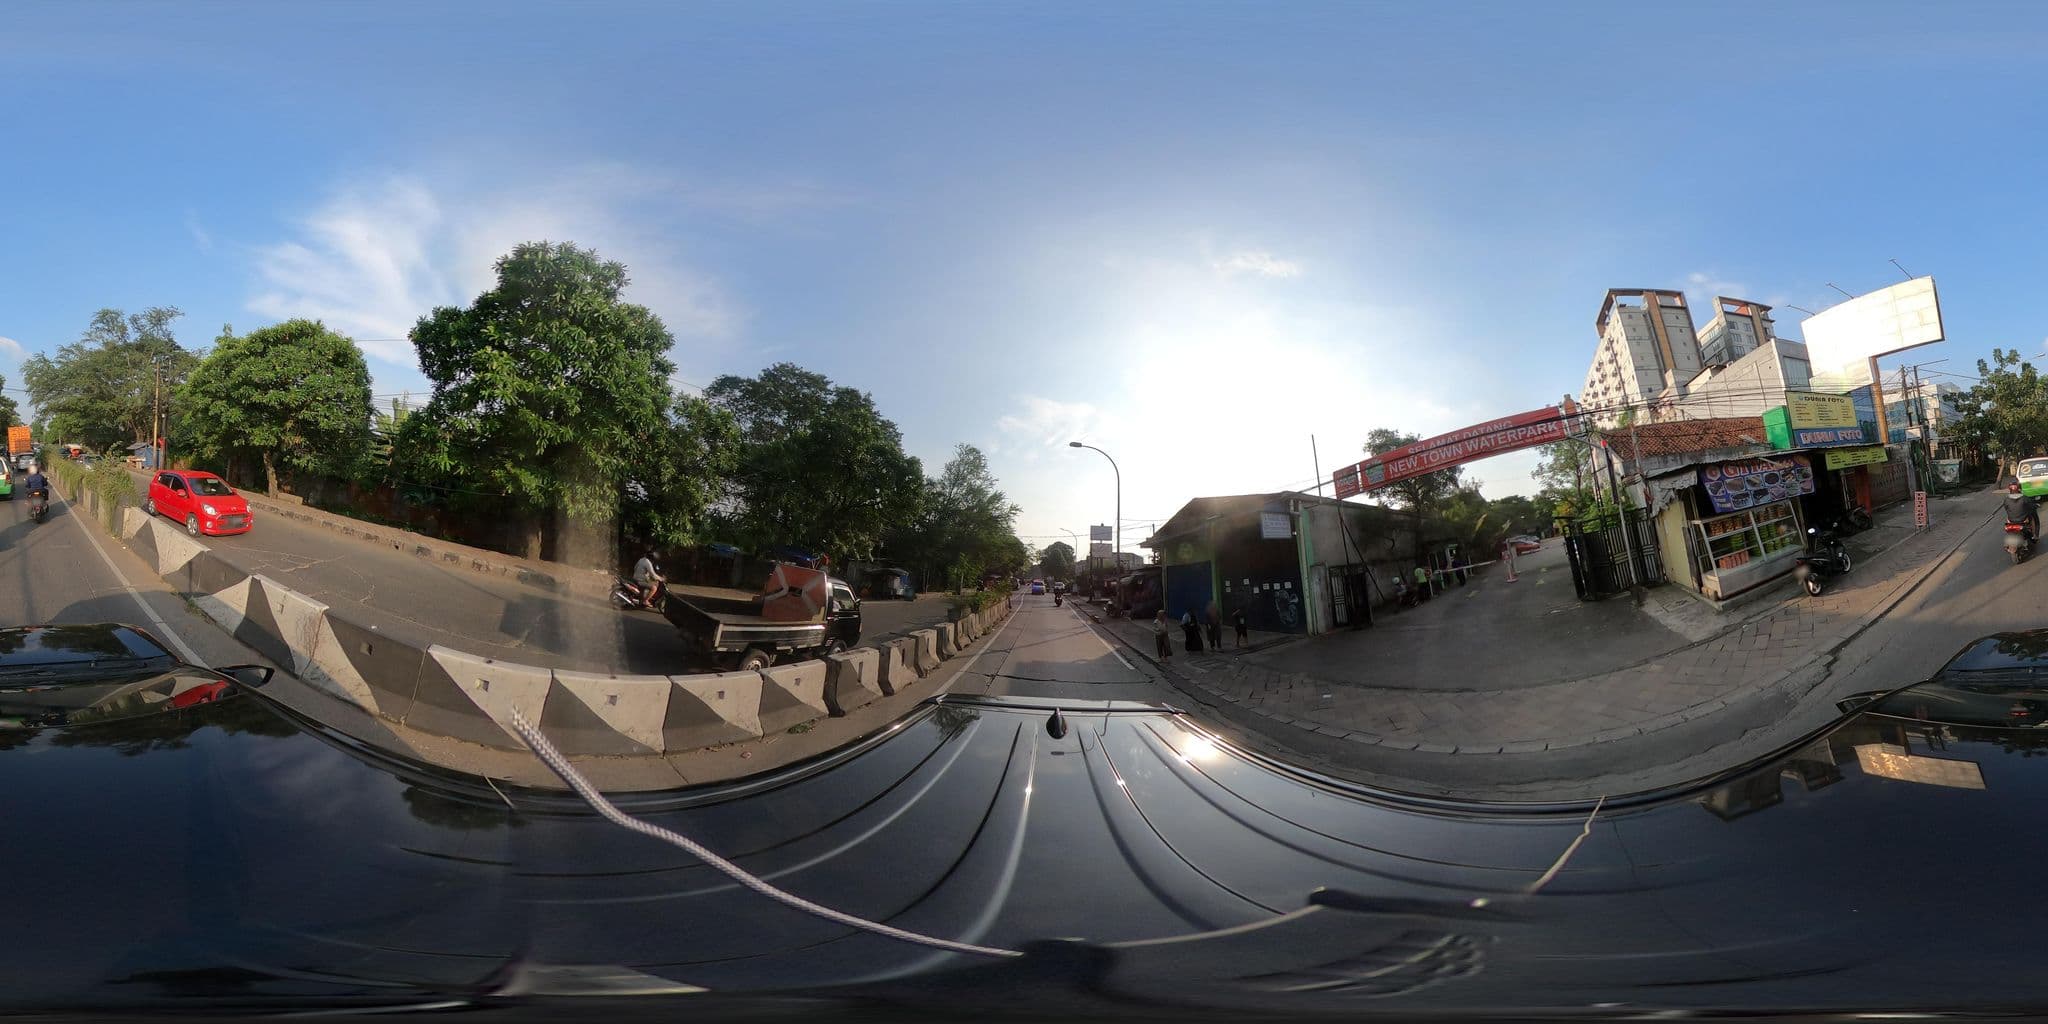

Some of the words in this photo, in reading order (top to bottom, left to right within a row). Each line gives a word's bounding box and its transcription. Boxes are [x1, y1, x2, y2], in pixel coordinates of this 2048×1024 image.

[1388, 454, 1418, 475] NEW
[1421, 443, 1463, 465] TOWN
[1464, 421, 1558, 453] WATERPARK
[1407, 433, 1459, 454] SELAMAT
[1463, 420, 1513, 439] DATANG
[1800, 431, 1838, 445] DUNIA
[1838, 429, 1863, 441] FOTO
